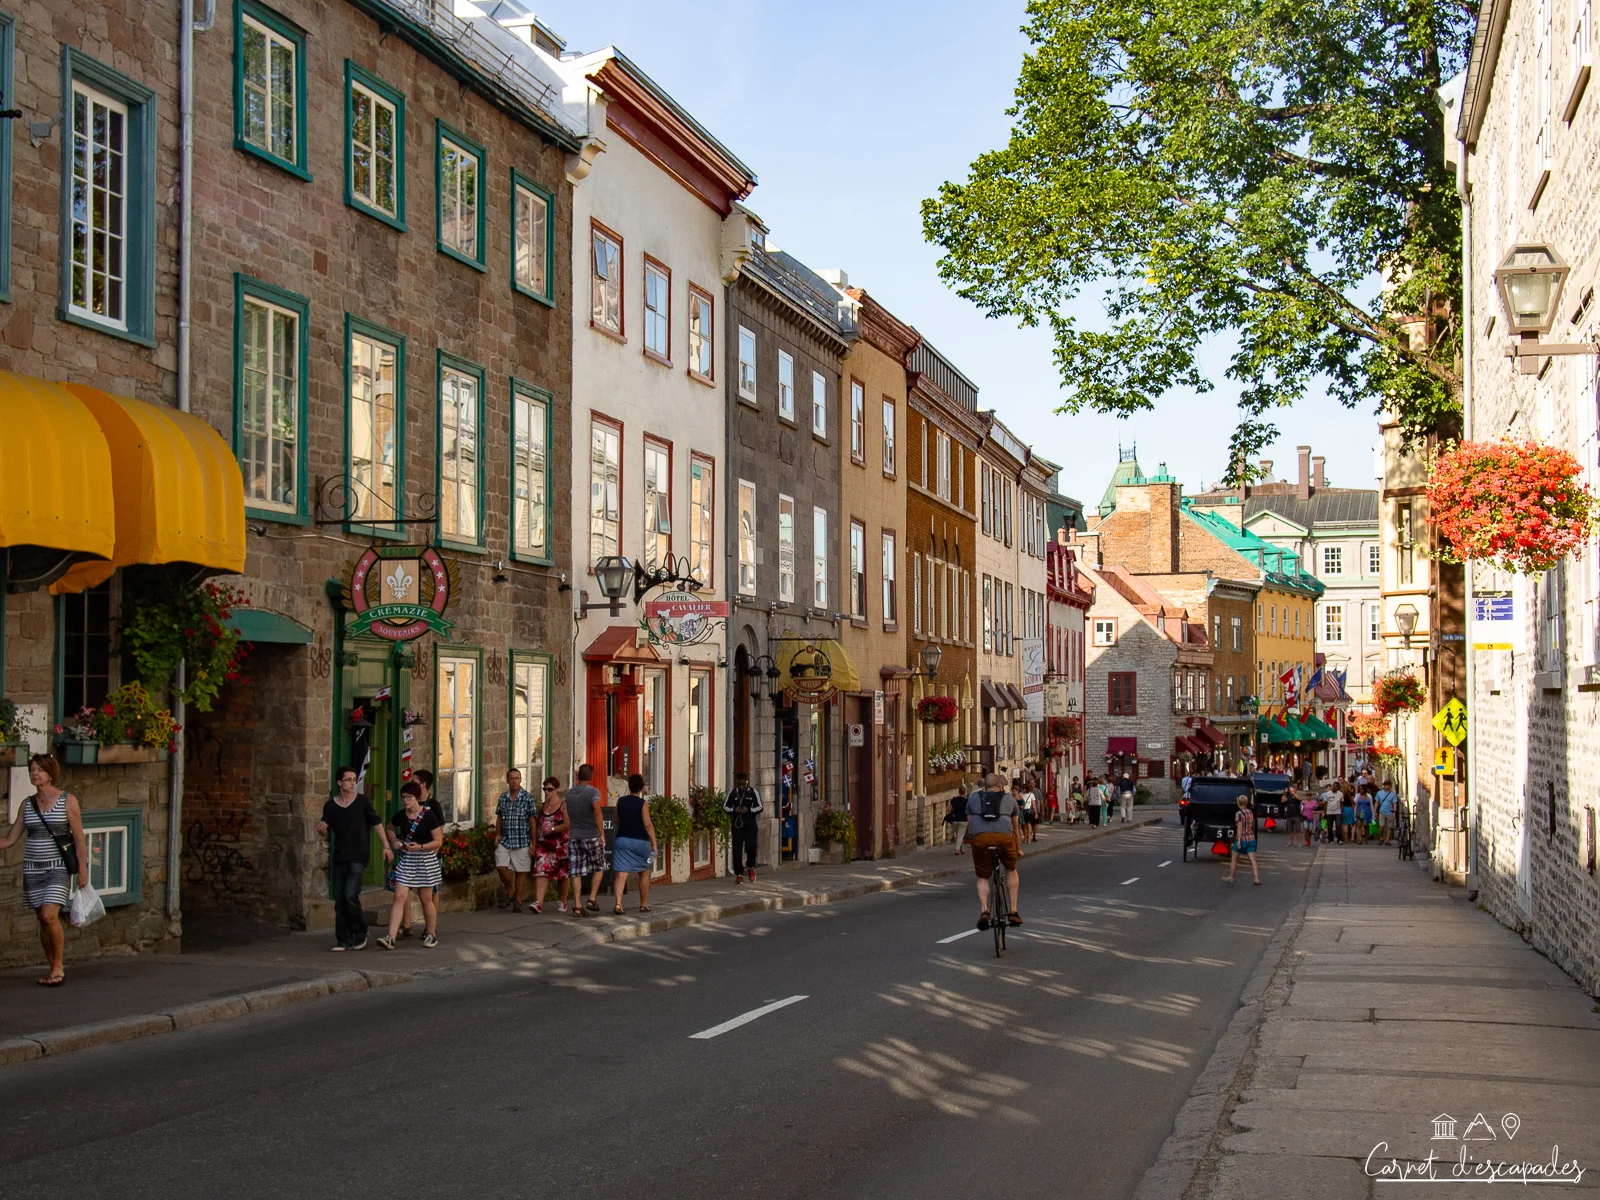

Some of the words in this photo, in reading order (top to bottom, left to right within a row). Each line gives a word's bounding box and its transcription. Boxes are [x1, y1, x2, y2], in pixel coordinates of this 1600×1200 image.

[381, 547, 417, 555] MAISON
[369, 606, 429, 618] CRÉMAZIE
[378, 625, 420, 637] SOUVENIRS
[793, 694, 810, 703] PORTE
[1216, 830, 1222, 838] 5
